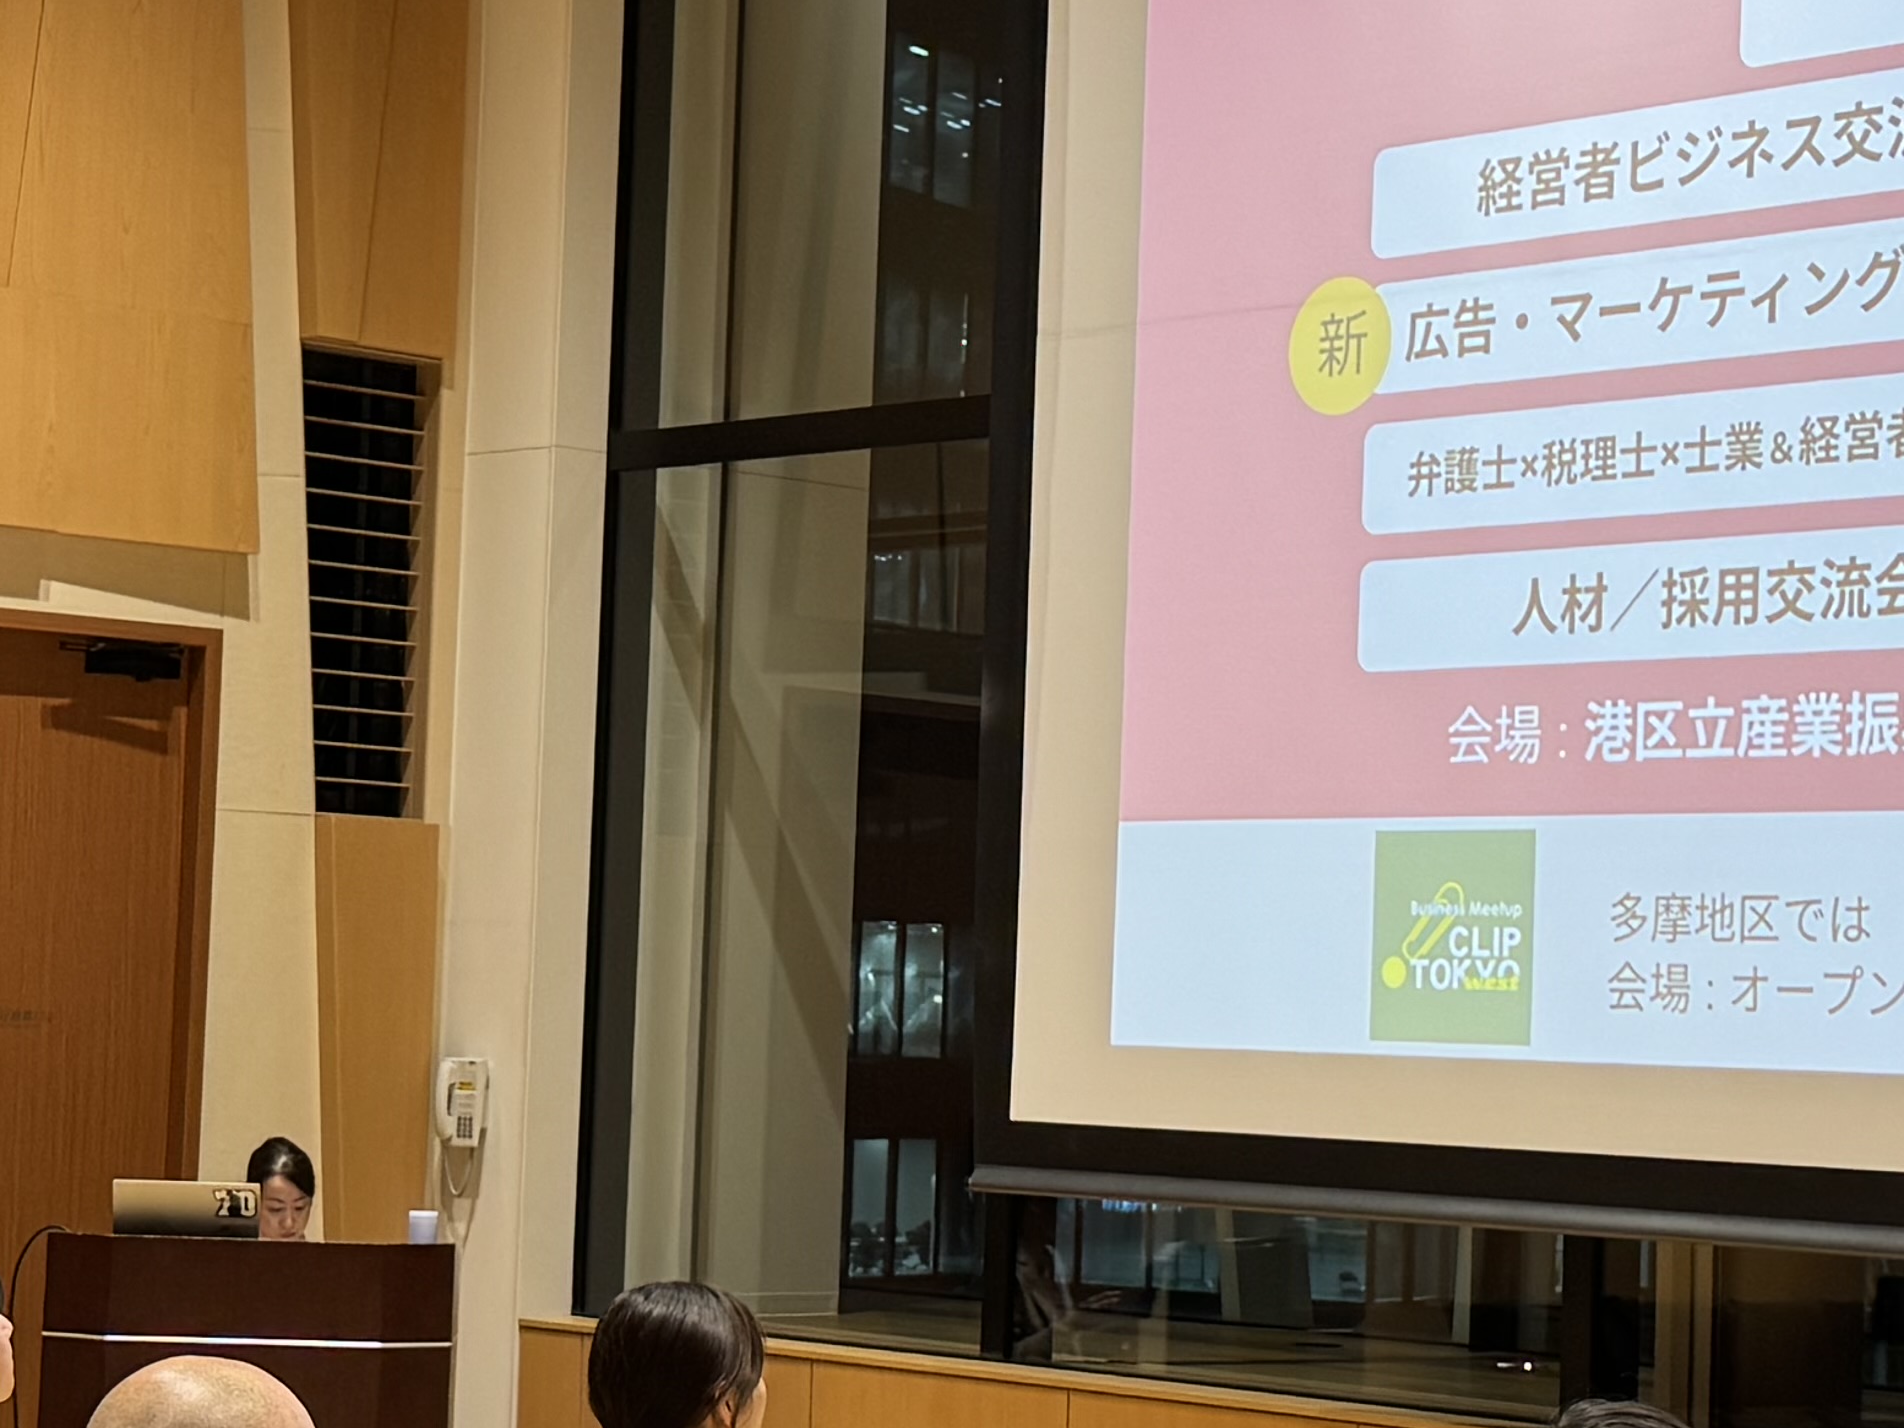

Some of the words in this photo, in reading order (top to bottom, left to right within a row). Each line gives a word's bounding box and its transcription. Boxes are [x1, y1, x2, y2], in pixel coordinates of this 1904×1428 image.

[1317, 308, 1370, 379] 新
[1410, 900, 1464, 917] Business
[1469, 900, 1523, 919] Meetup
[1448, 925, 1522, 958] CLIP
